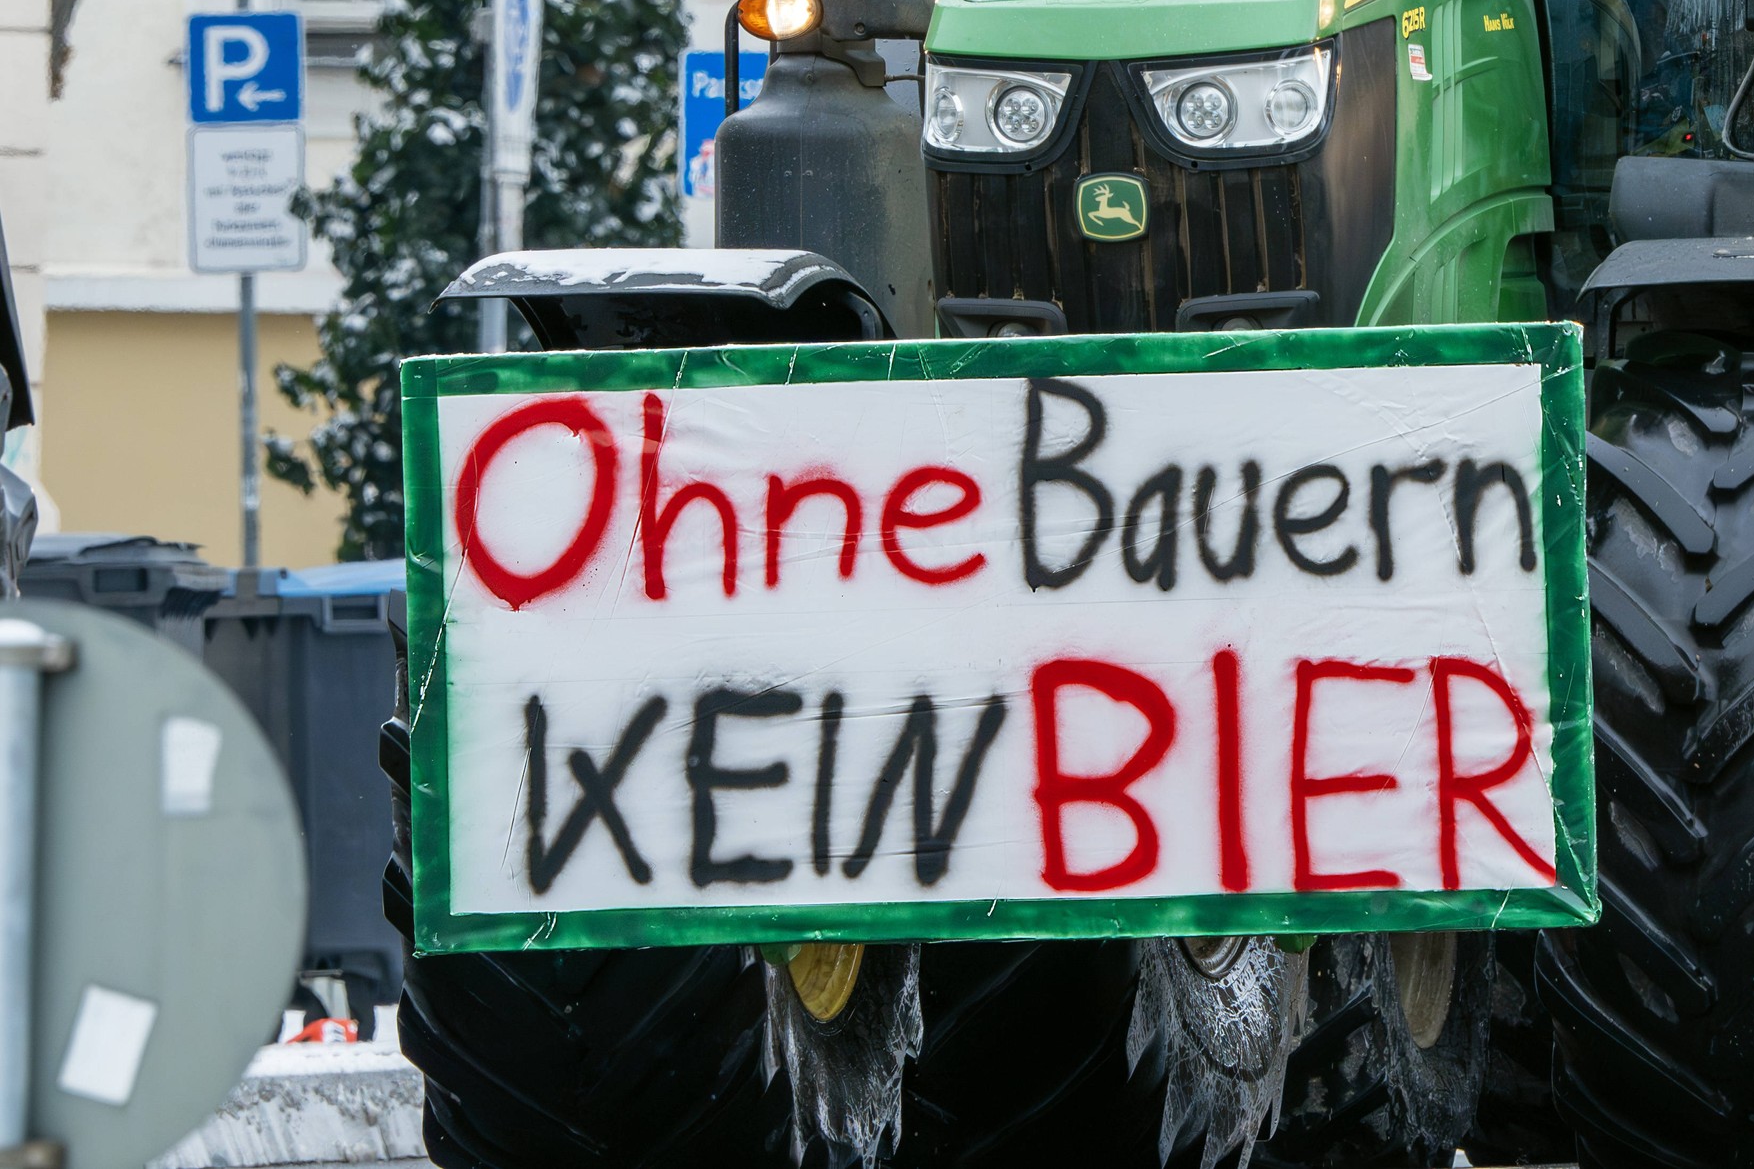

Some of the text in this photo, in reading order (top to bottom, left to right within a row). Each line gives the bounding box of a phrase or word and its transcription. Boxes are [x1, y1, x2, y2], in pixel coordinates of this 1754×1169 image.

[203, 24, 270, 113] P
[1402, 6, 1426, 39] 6215R
[454, 377, 1538, 613] Ohne Bauern
[521, 646, 1558, 896] KEIN BIER
